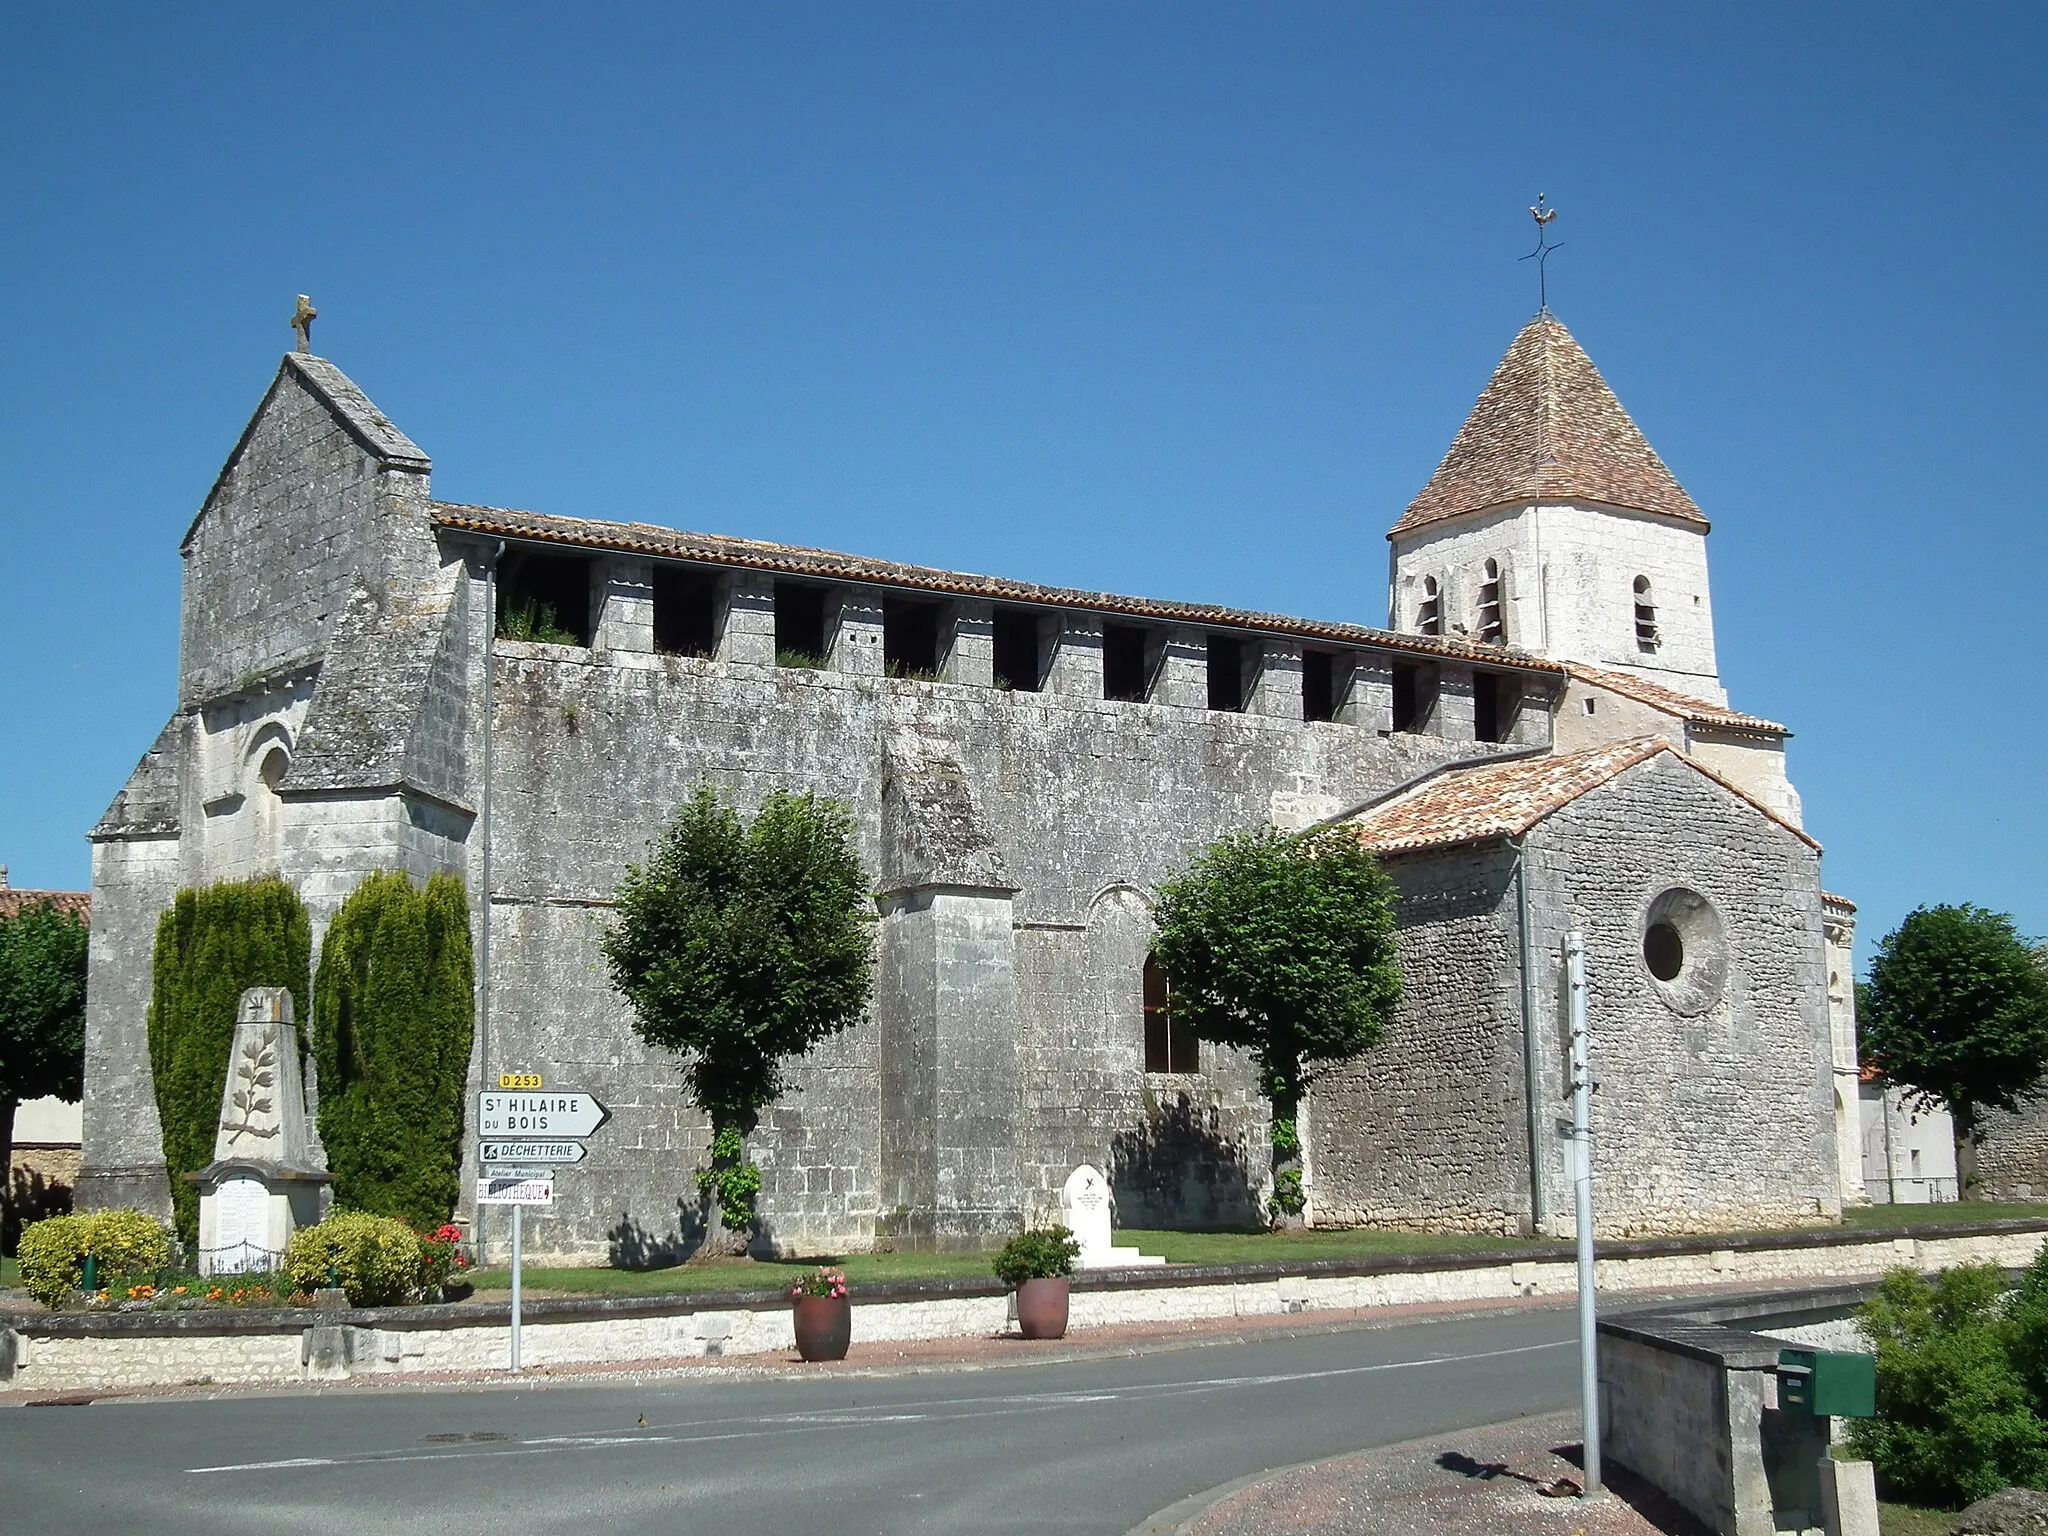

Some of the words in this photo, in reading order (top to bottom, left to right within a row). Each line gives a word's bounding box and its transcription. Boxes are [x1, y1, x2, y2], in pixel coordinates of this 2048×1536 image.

[503, 1076, 510, 1086] D
[514, 1076, 539, 1086] 253
[509, 1099, 579, 1113] HILAIRE
[485, 1120, 499, 1129] DU
[508, 1116, 549, 1130] BOIS
[501, 1142, 574, 1156] DÉCHETTERIE
[491, 1169, 512, 1178] Atelier
[515, 1170, 546, 1179] Municipal
